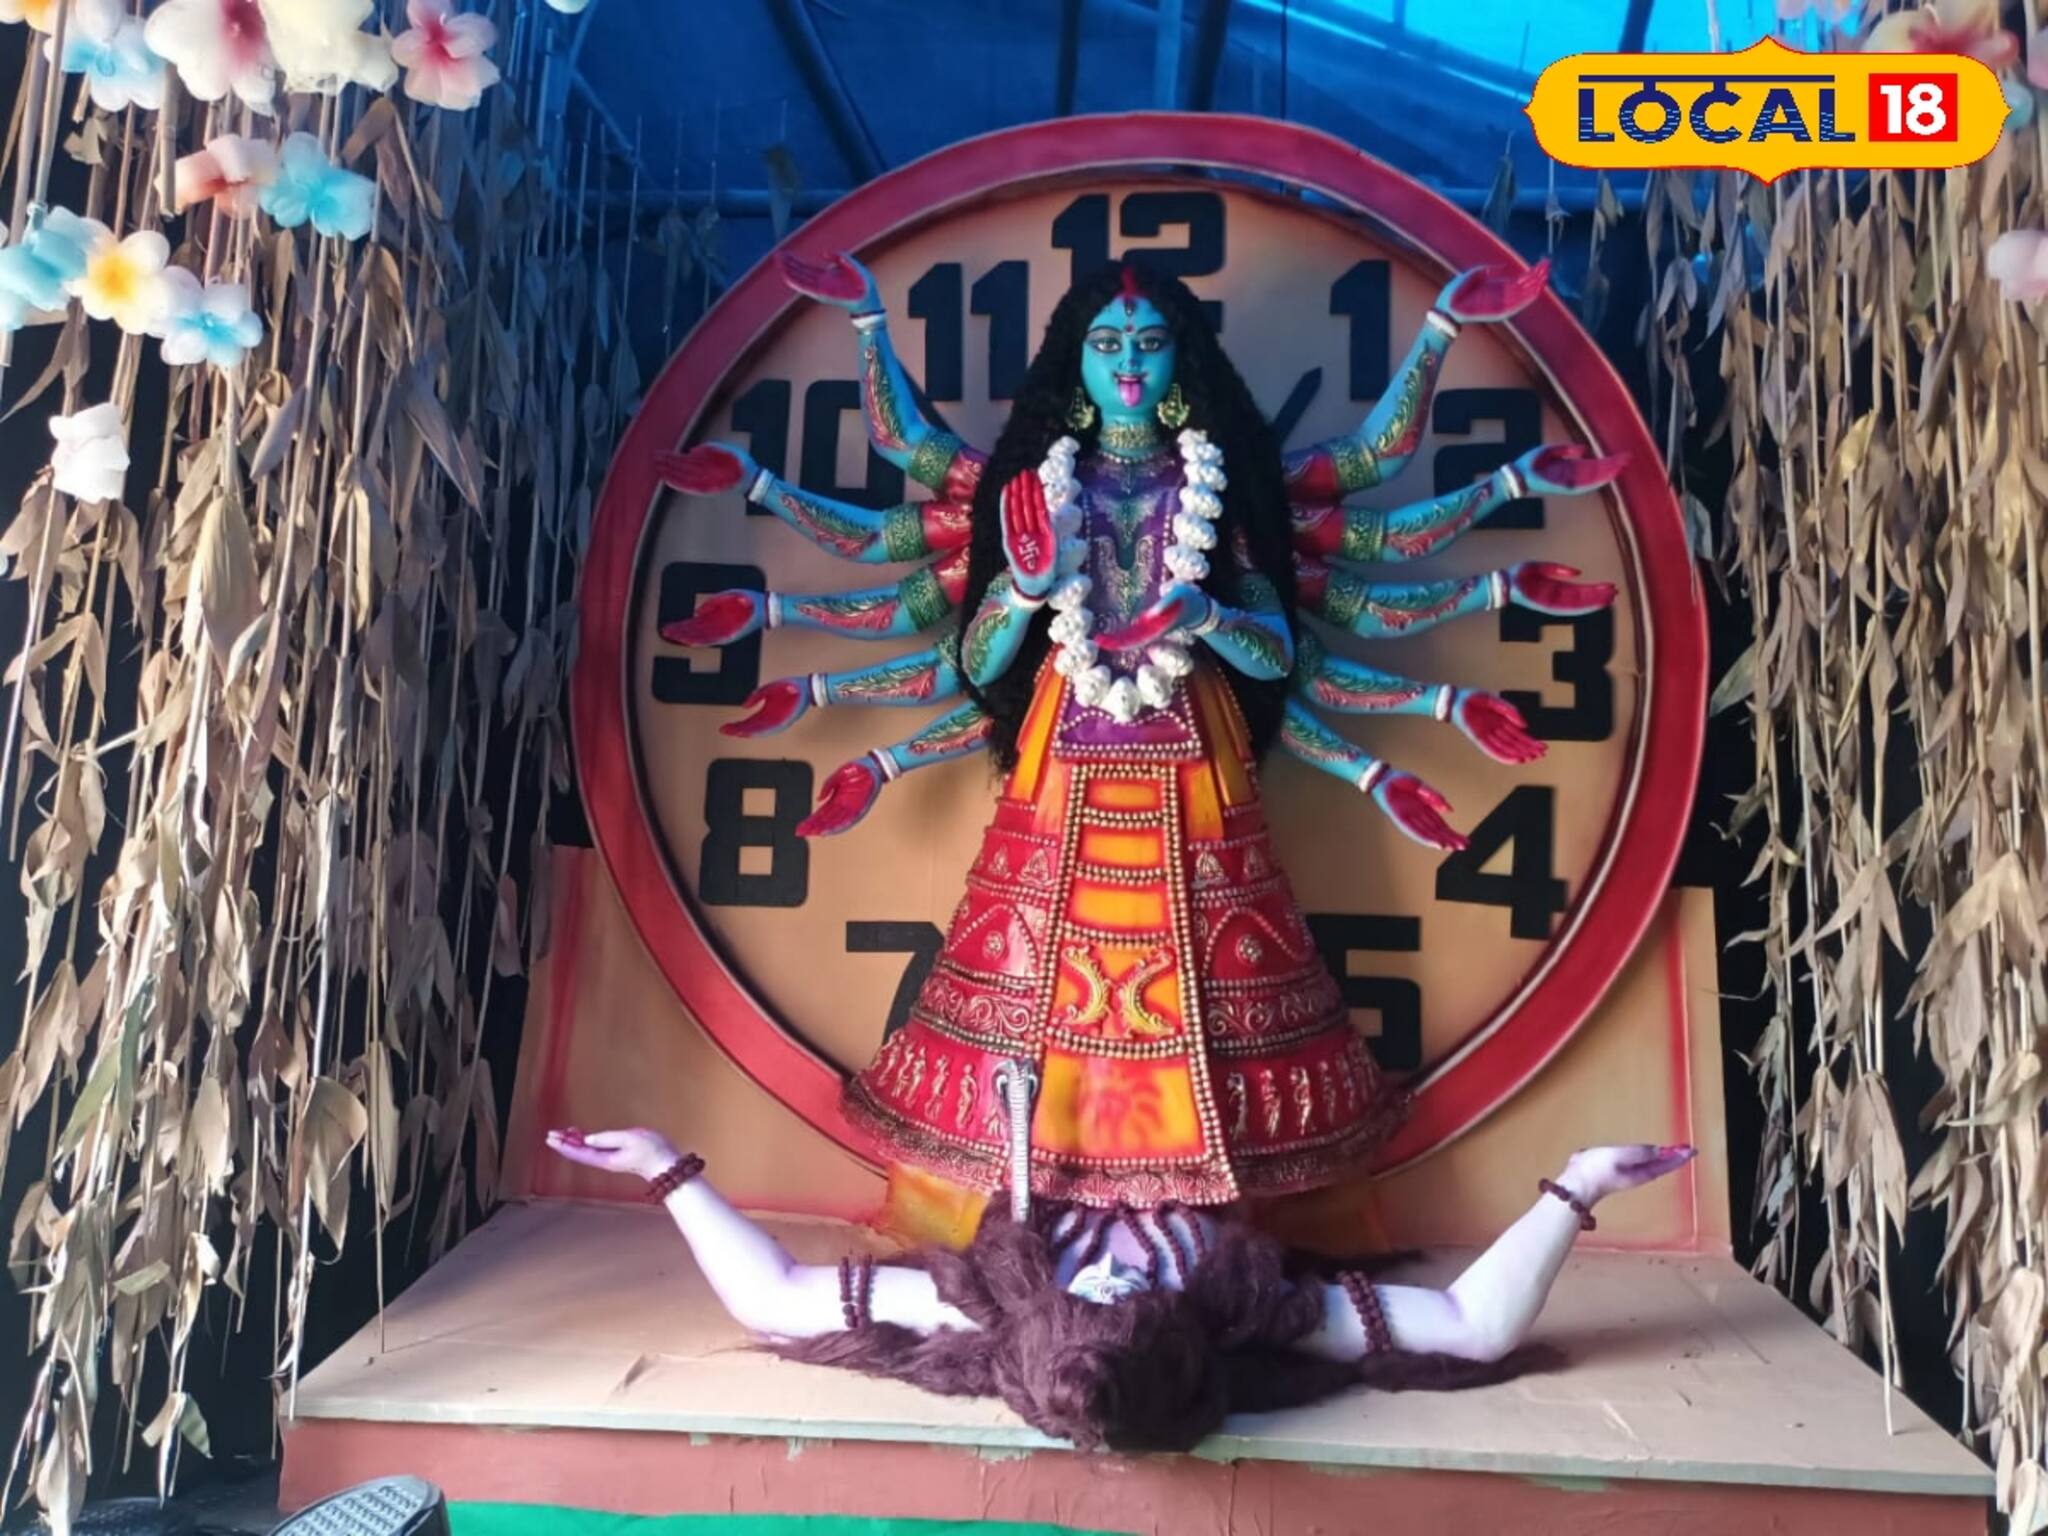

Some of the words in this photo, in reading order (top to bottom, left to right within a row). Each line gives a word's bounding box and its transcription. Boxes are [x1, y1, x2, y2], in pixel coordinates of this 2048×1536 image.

[908, 260, 1029, 401] 11
[1051, 191, 1227, 334] 12
[1330, 260, 1391, 401] 1
[732, 379, 906, 516] 10
[1433, 388, 1545, 529] 2
[652, 561, 767, 705] 9
[1500, 592, 1616, 742] 3
[700, 758, 814, 908] 8
[1435, 785, 1569, 940] 4
